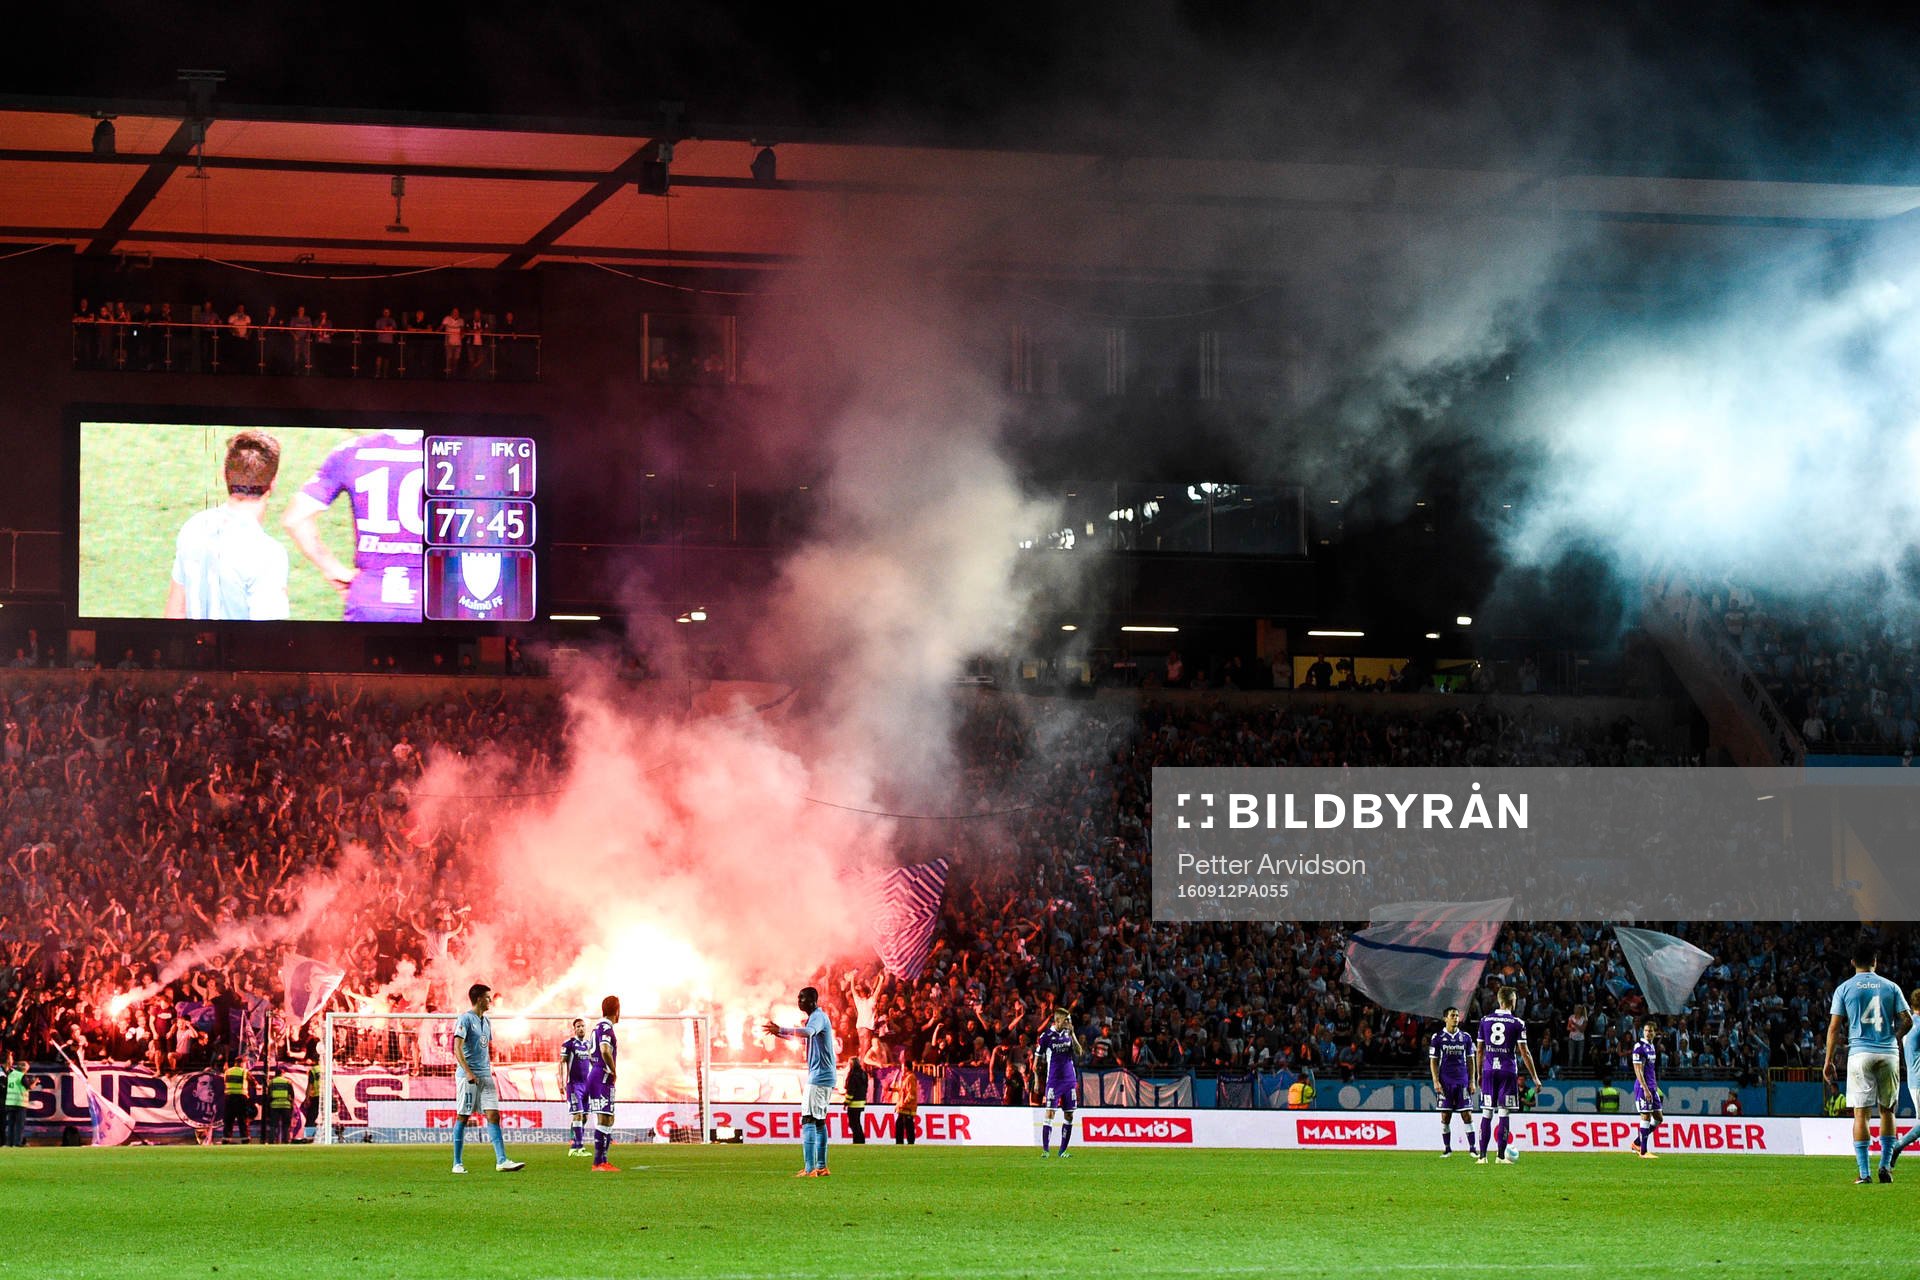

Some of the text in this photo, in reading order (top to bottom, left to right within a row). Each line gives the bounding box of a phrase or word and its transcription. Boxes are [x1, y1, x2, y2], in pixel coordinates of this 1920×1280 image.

[431, 442, 462, 456] MFF
[491, 443, 514, 457] IFK
[518, 443, 530, 458] G
[436, 461, 455, 490] 2
[508, 463, 520, 492] 1
[436, 508, 525, 539] 77:45
[1856, 981, 1881, 989] Safari
[1861, 995, 1883, 1032] 4
[1490, 1022, 1506, 1046] 8
[398, 1129, 564, 1144] Halva pret md BroPass
[1089, 1120, 1170, 1138] MALMÖ
[1302, 1122, 1376, 1141] MALMÖ
